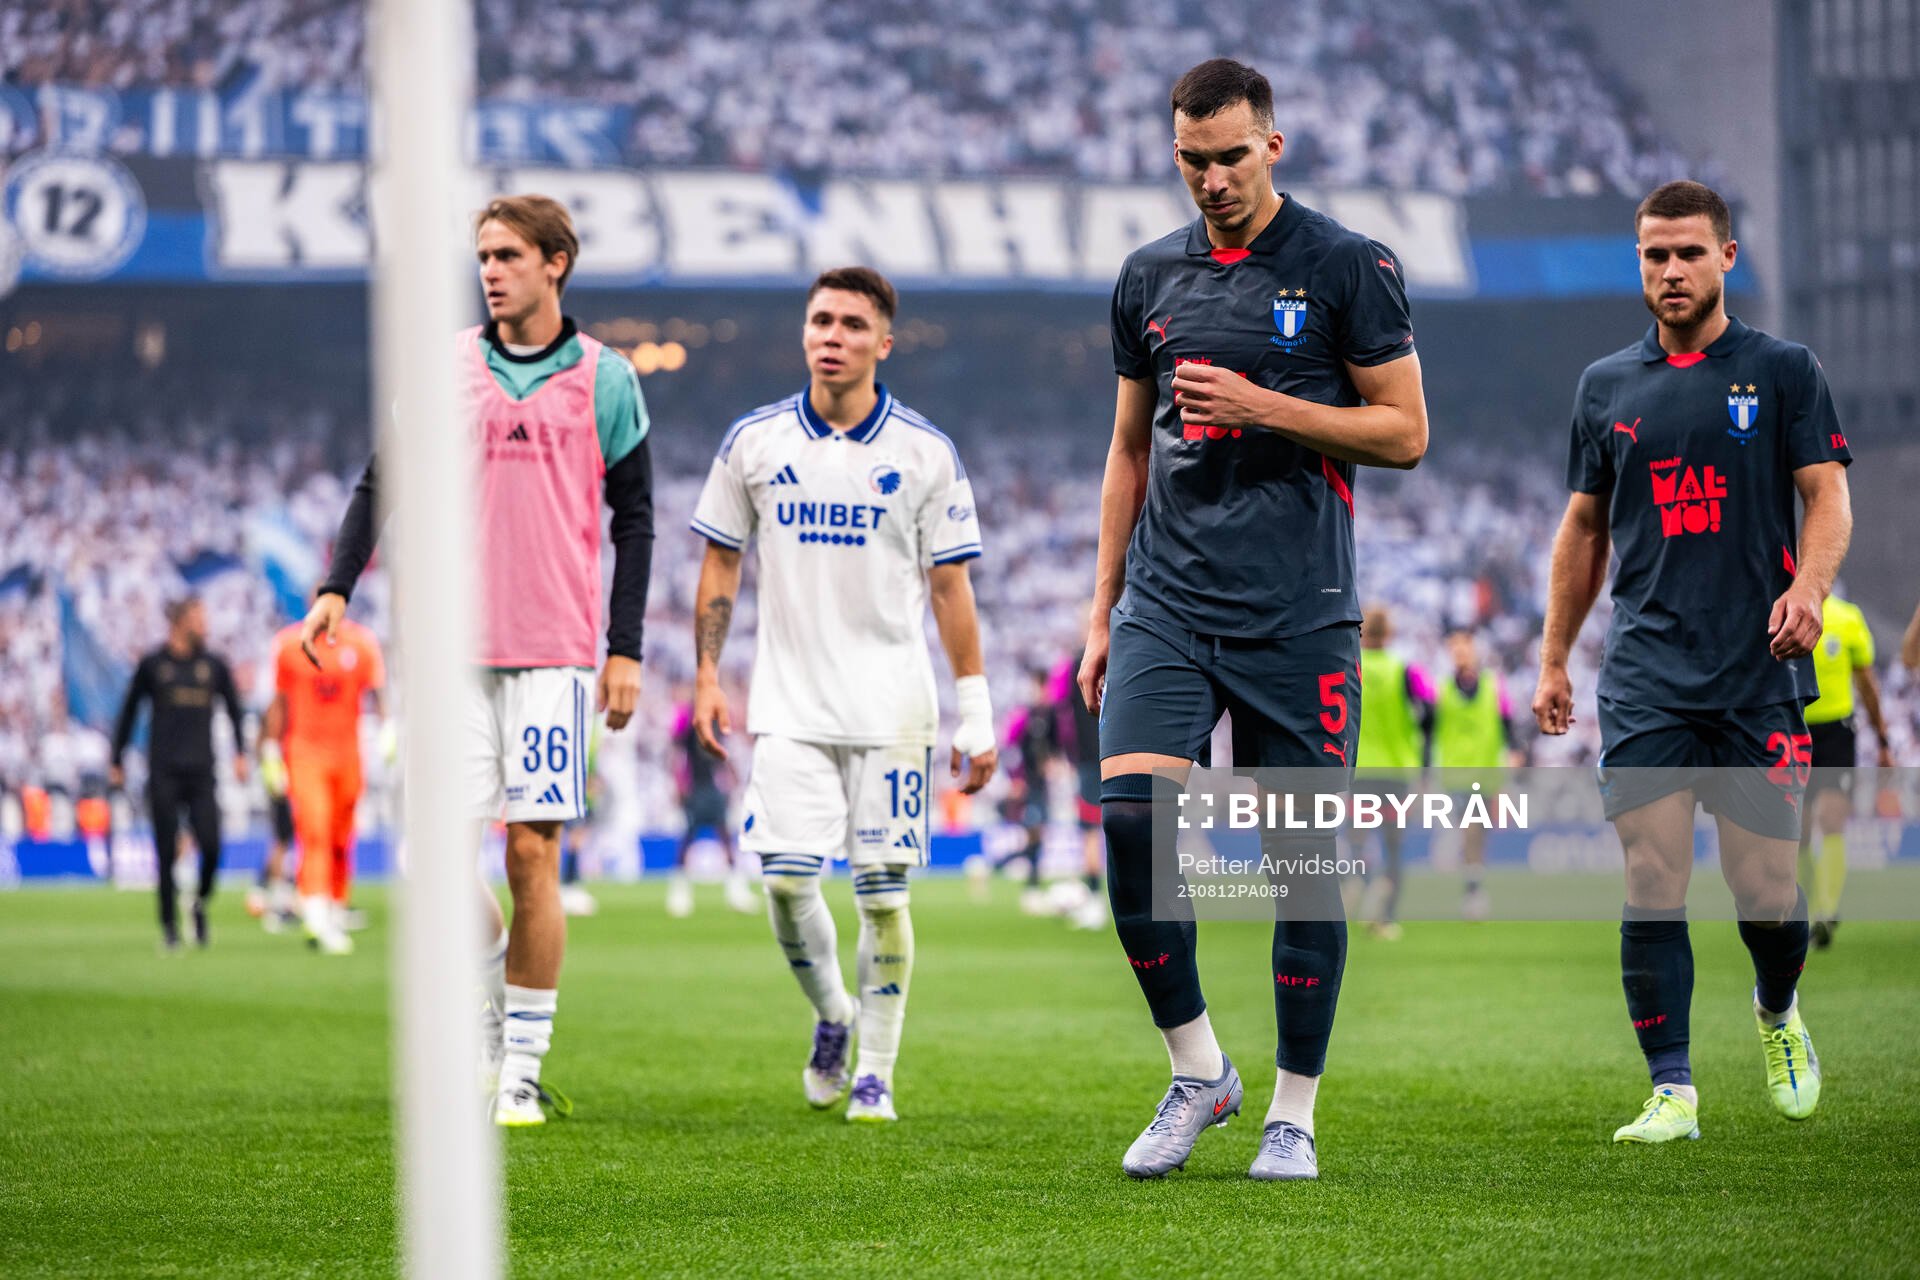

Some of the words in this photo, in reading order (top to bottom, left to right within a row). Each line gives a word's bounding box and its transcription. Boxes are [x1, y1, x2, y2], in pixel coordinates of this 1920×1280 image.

[41, 184, 104, 238] 12
[208, 158, 1470, 291] KBENHAN
[777, 502, 887, 529] UNIBET
[1318, 671, 1348, 734] 5
[523, 726, 568, 773] 36
[1766, 731, 1812, 788] 25
[884, 769, 922, 818] 13
[1276, 973, 1320, 988] MFF
